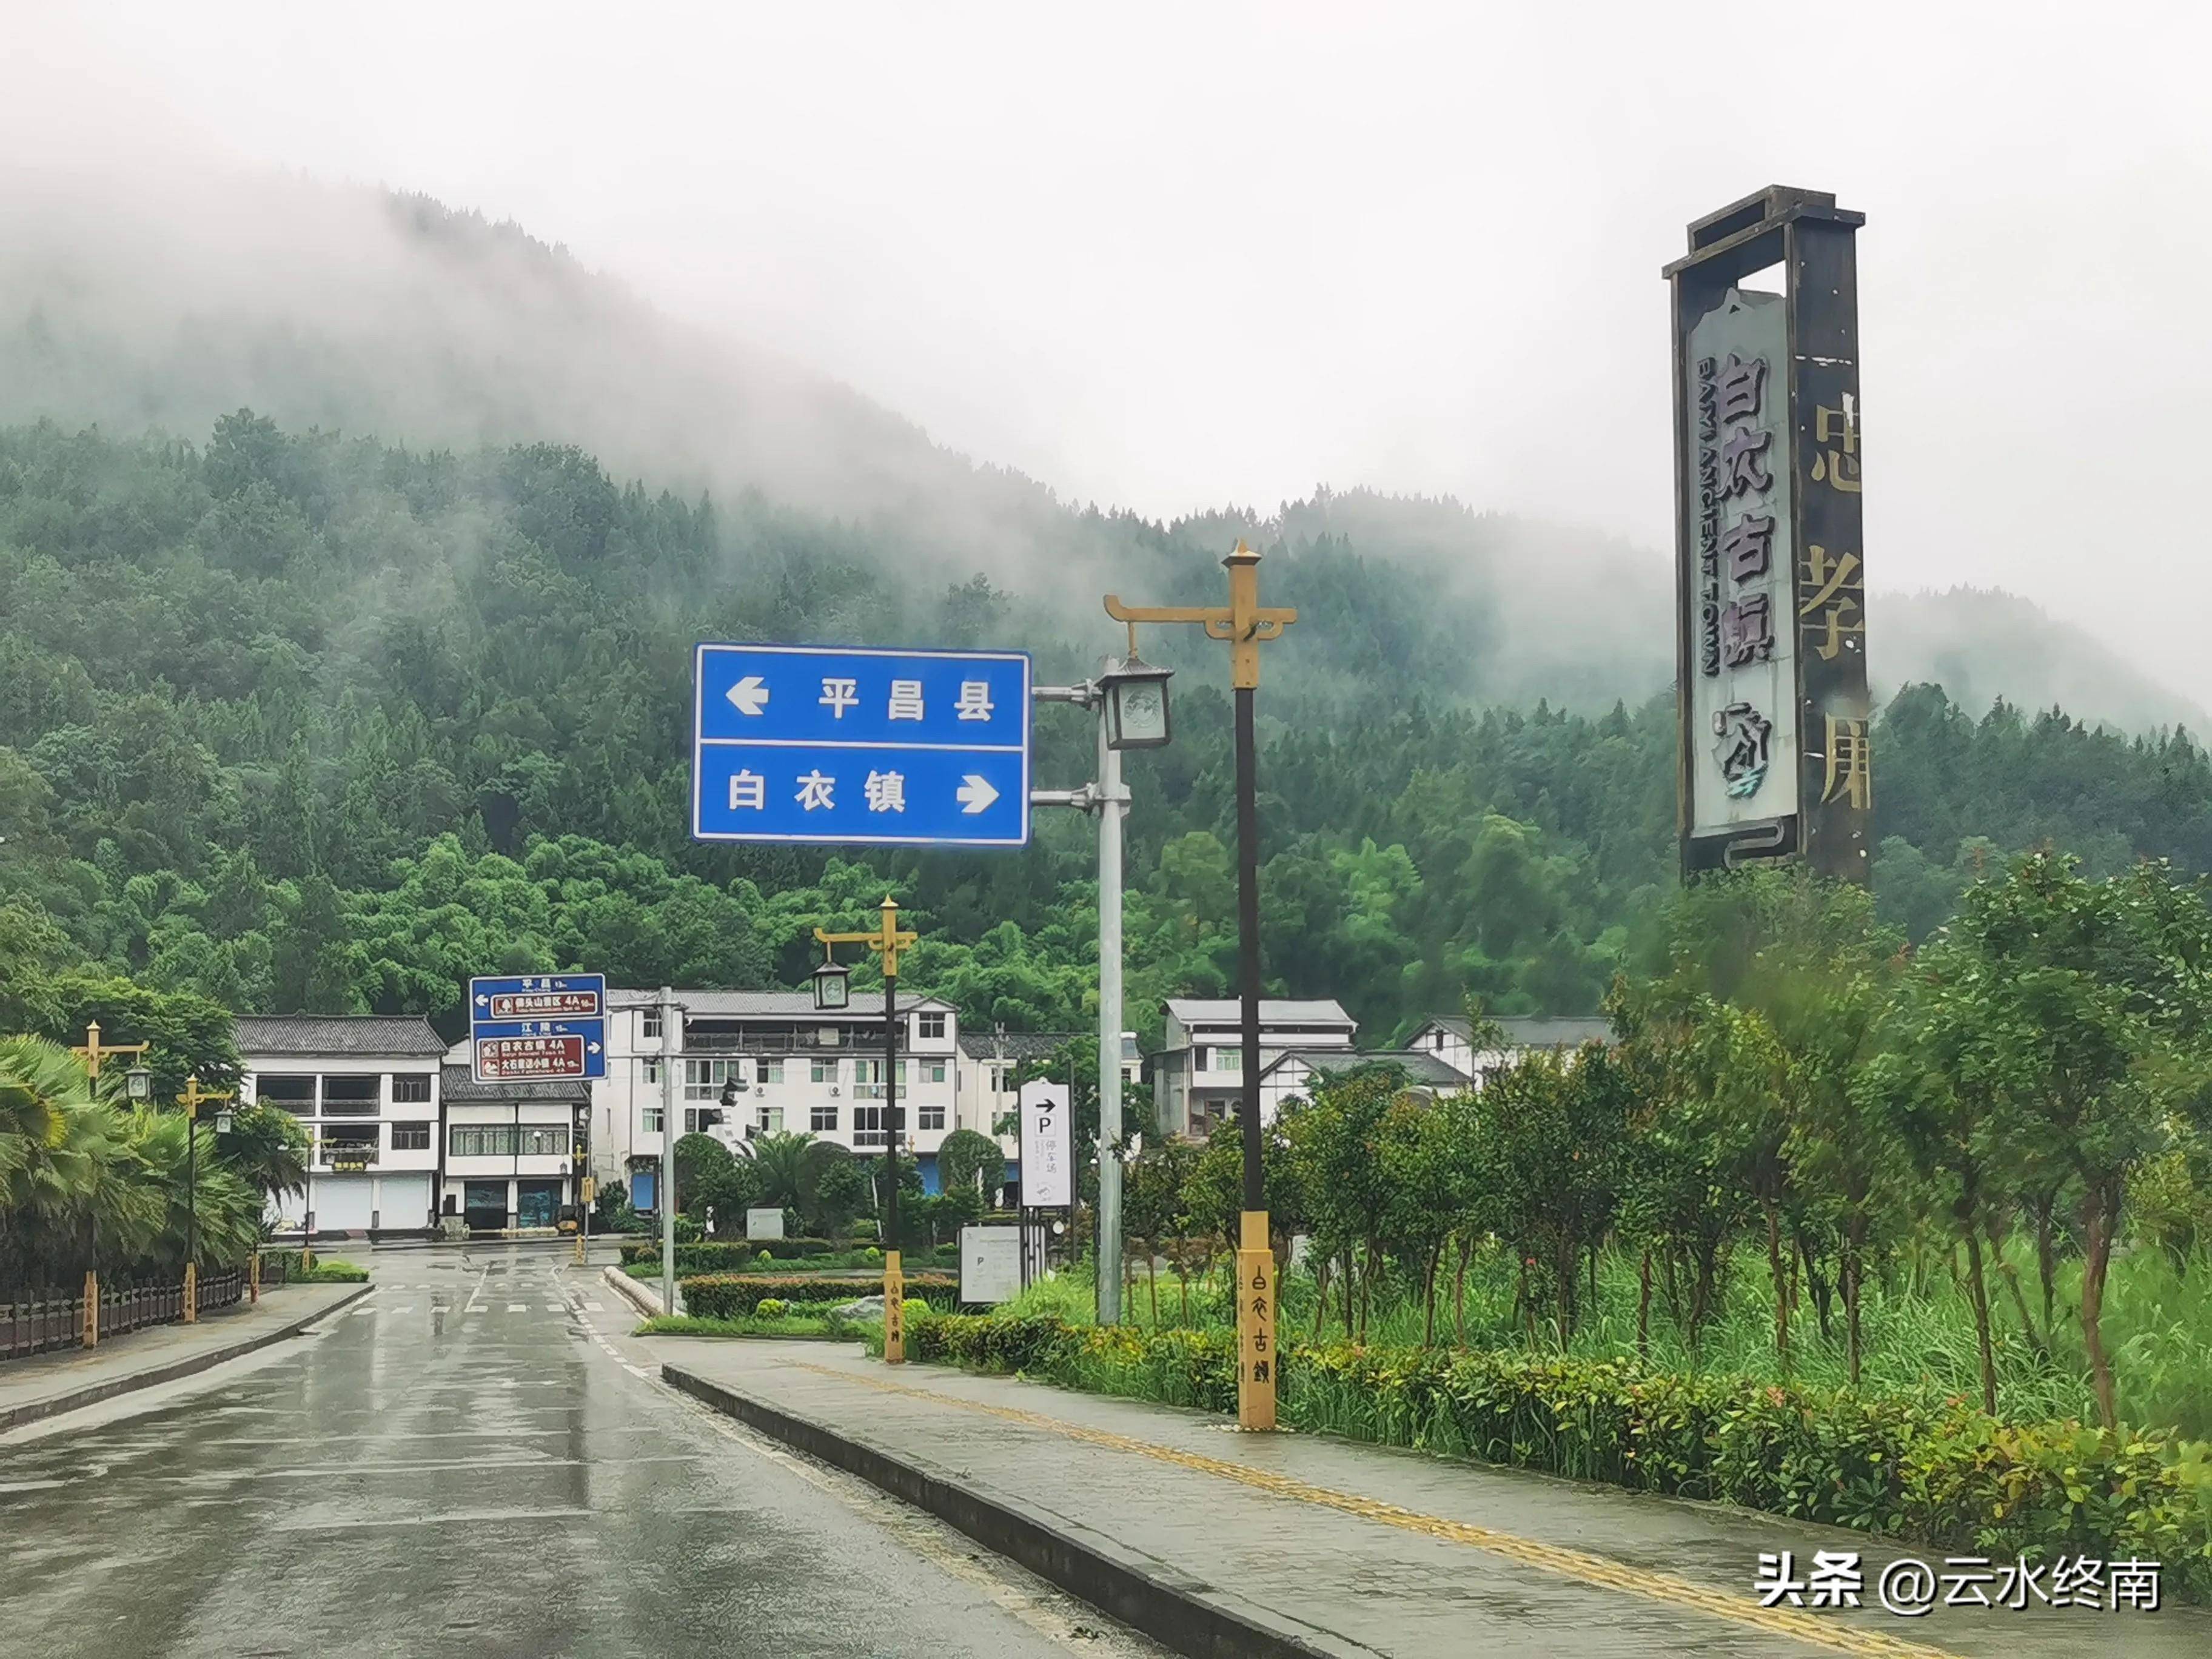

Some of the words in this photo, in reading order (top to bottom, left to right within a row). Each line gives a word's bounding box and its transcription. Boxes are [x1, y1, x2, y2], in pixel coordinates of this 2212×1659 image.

[1699, 447, 1720, 578] ANCIENT
[1700, 581, 1720, 679] TOWN
[819, 677, 994, 722] 平昌县
[729, 768, 906, 813] 白衣镇
[1039, 1117, 1051, 1134] P
